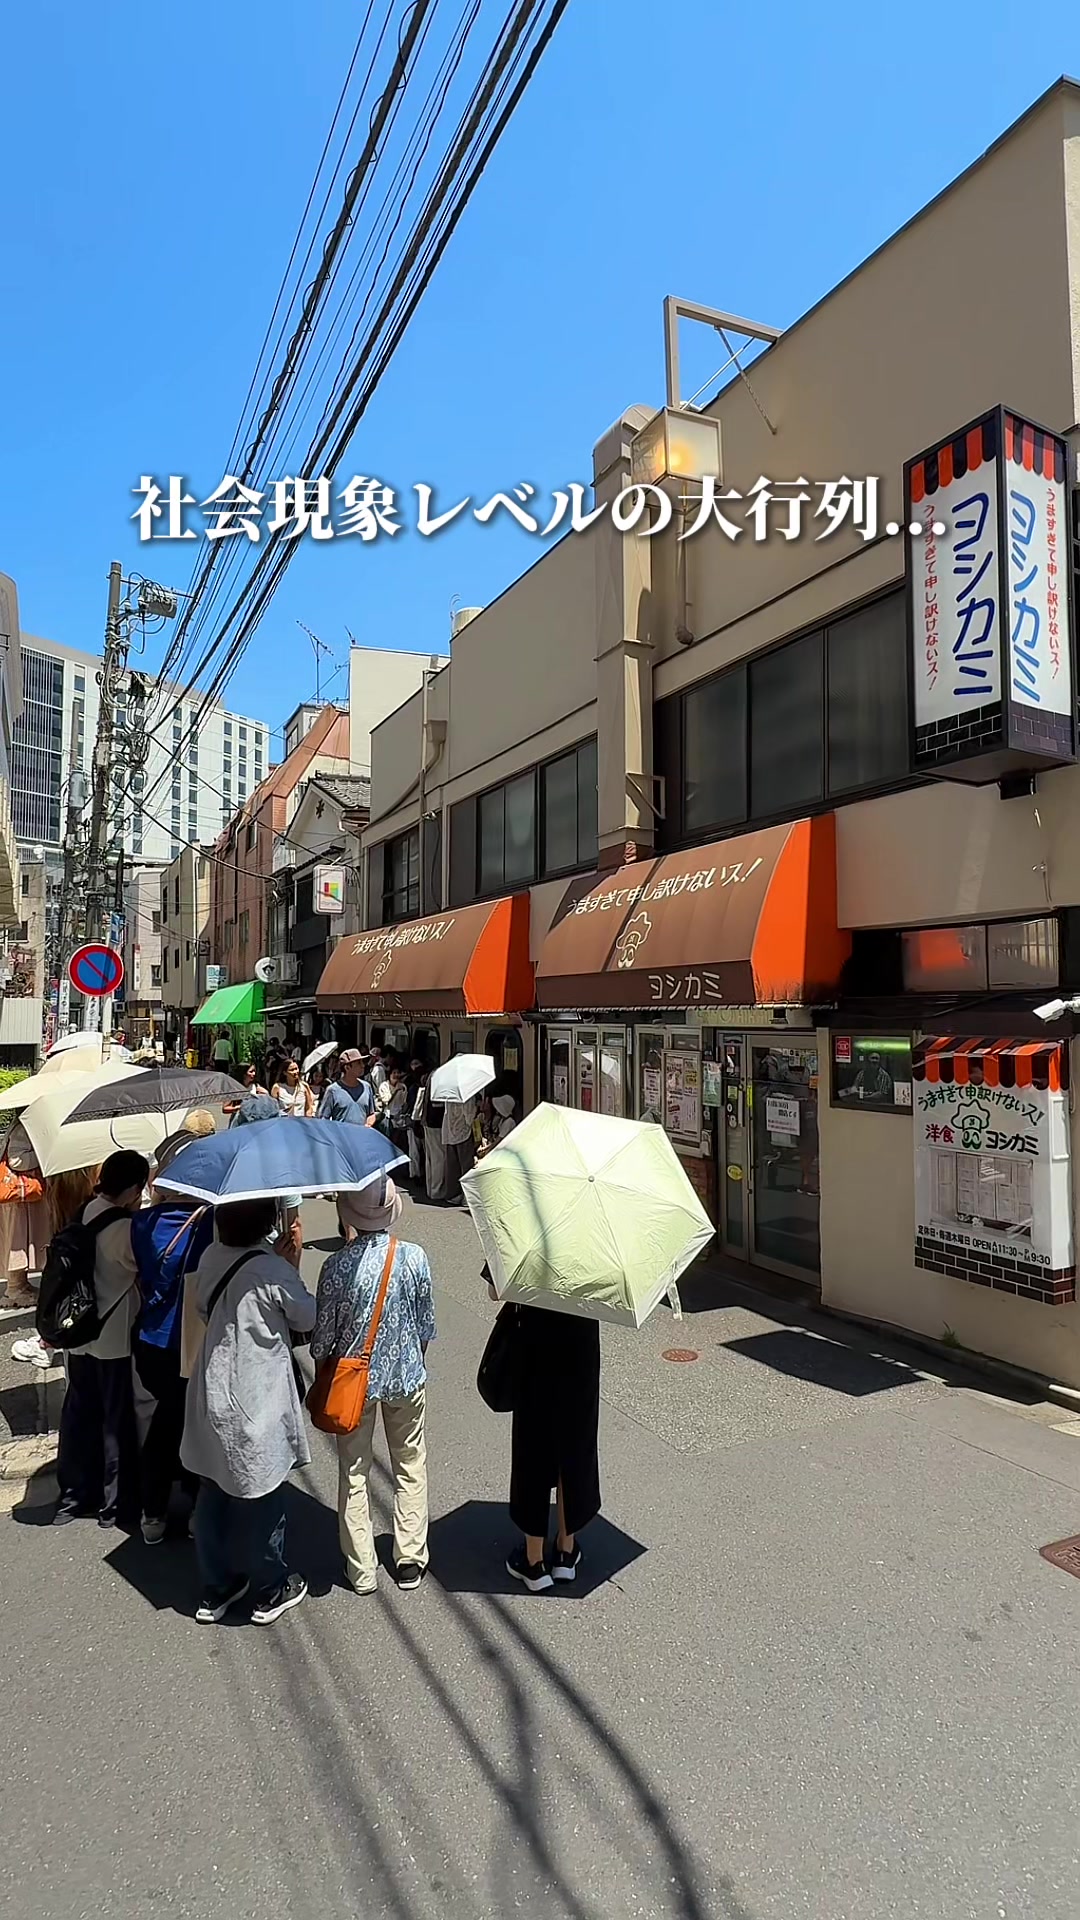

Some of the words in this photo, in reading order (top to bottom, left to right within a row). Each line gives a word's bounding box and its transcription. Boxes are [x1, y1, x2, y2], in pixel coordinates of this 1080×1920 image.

[951, 492, 995, 695] ヨシカミ
[1009, 490, 1041, 702] ヨシカミ
[648, 970, 723, 999] ヨシカミ
[925, 1123, 955, 1143] 洋食
[985, 1130, 1040, 1155] ヨシカミ
[972, 1237, 992, 1251] OPEN
[1031, 1253, 1051, 1266] 9:30
